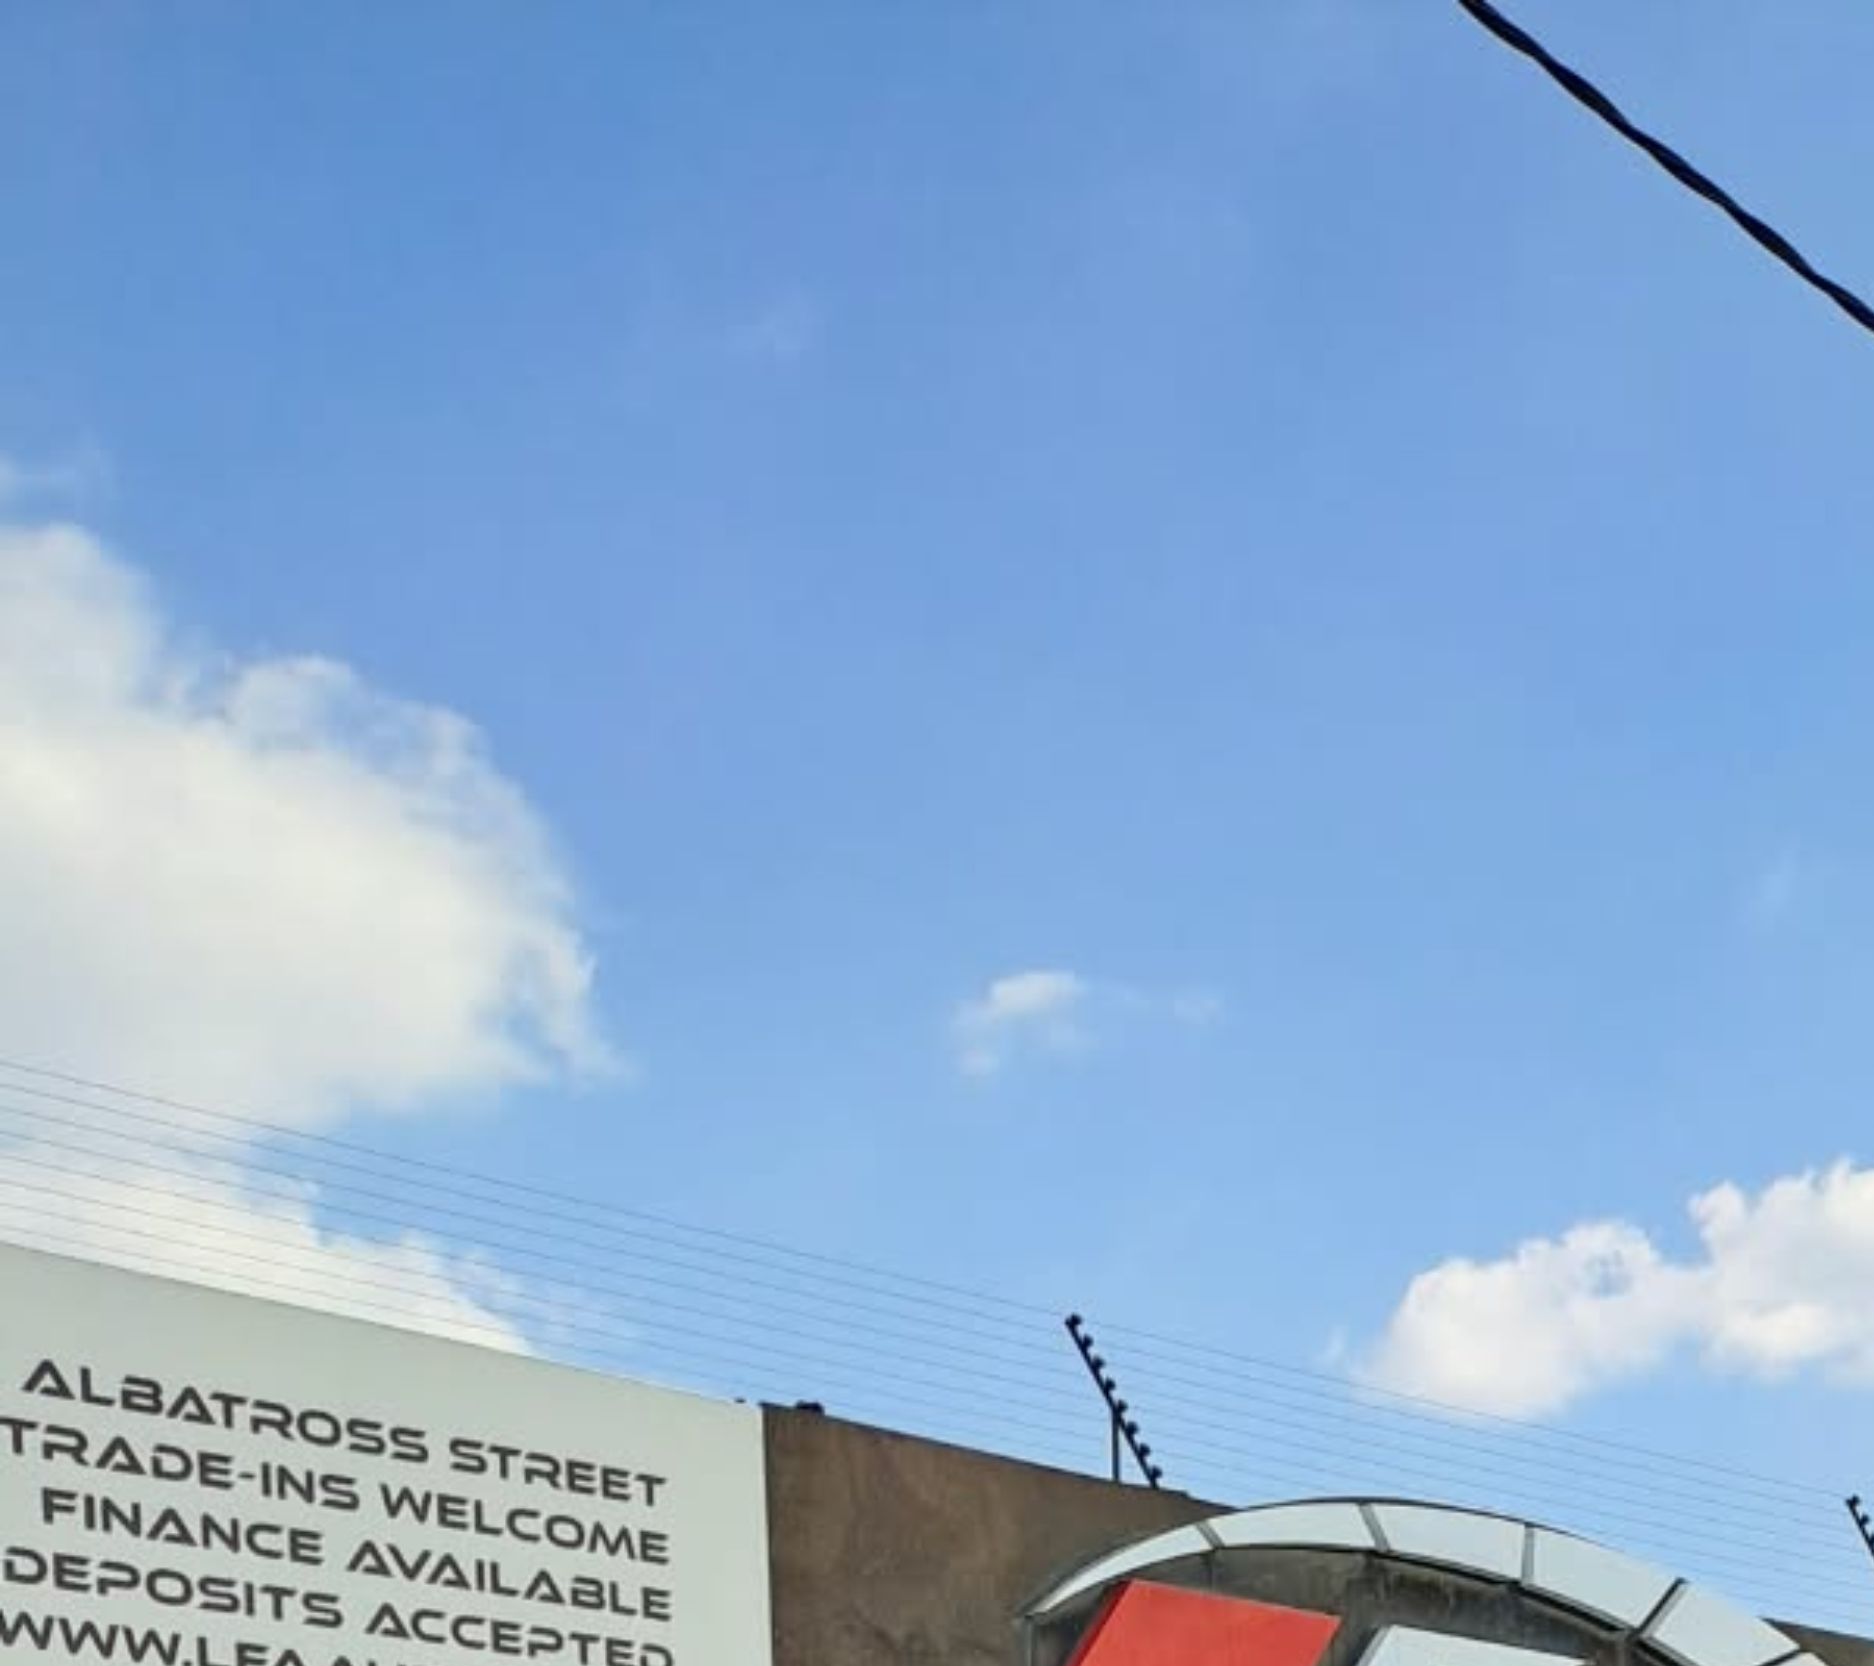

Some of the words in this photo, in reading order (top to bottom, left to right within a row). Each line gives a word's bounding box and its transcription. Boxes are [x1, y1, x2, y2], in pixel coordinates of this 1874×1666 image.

[0, 1416, 361, 1510] TRADE-INS
[380, 1482, 670, 1565] WELCOME
[23, 1358, 429, 1463] ALBATROSS
[449, 1438, 668, 1507] STREET
[3, 1546, 345, 1629] DEPOSITS
[41, 1486, 325, 1564] FINANCE
[346, 1539, 673, 1622] AVAILABLE
